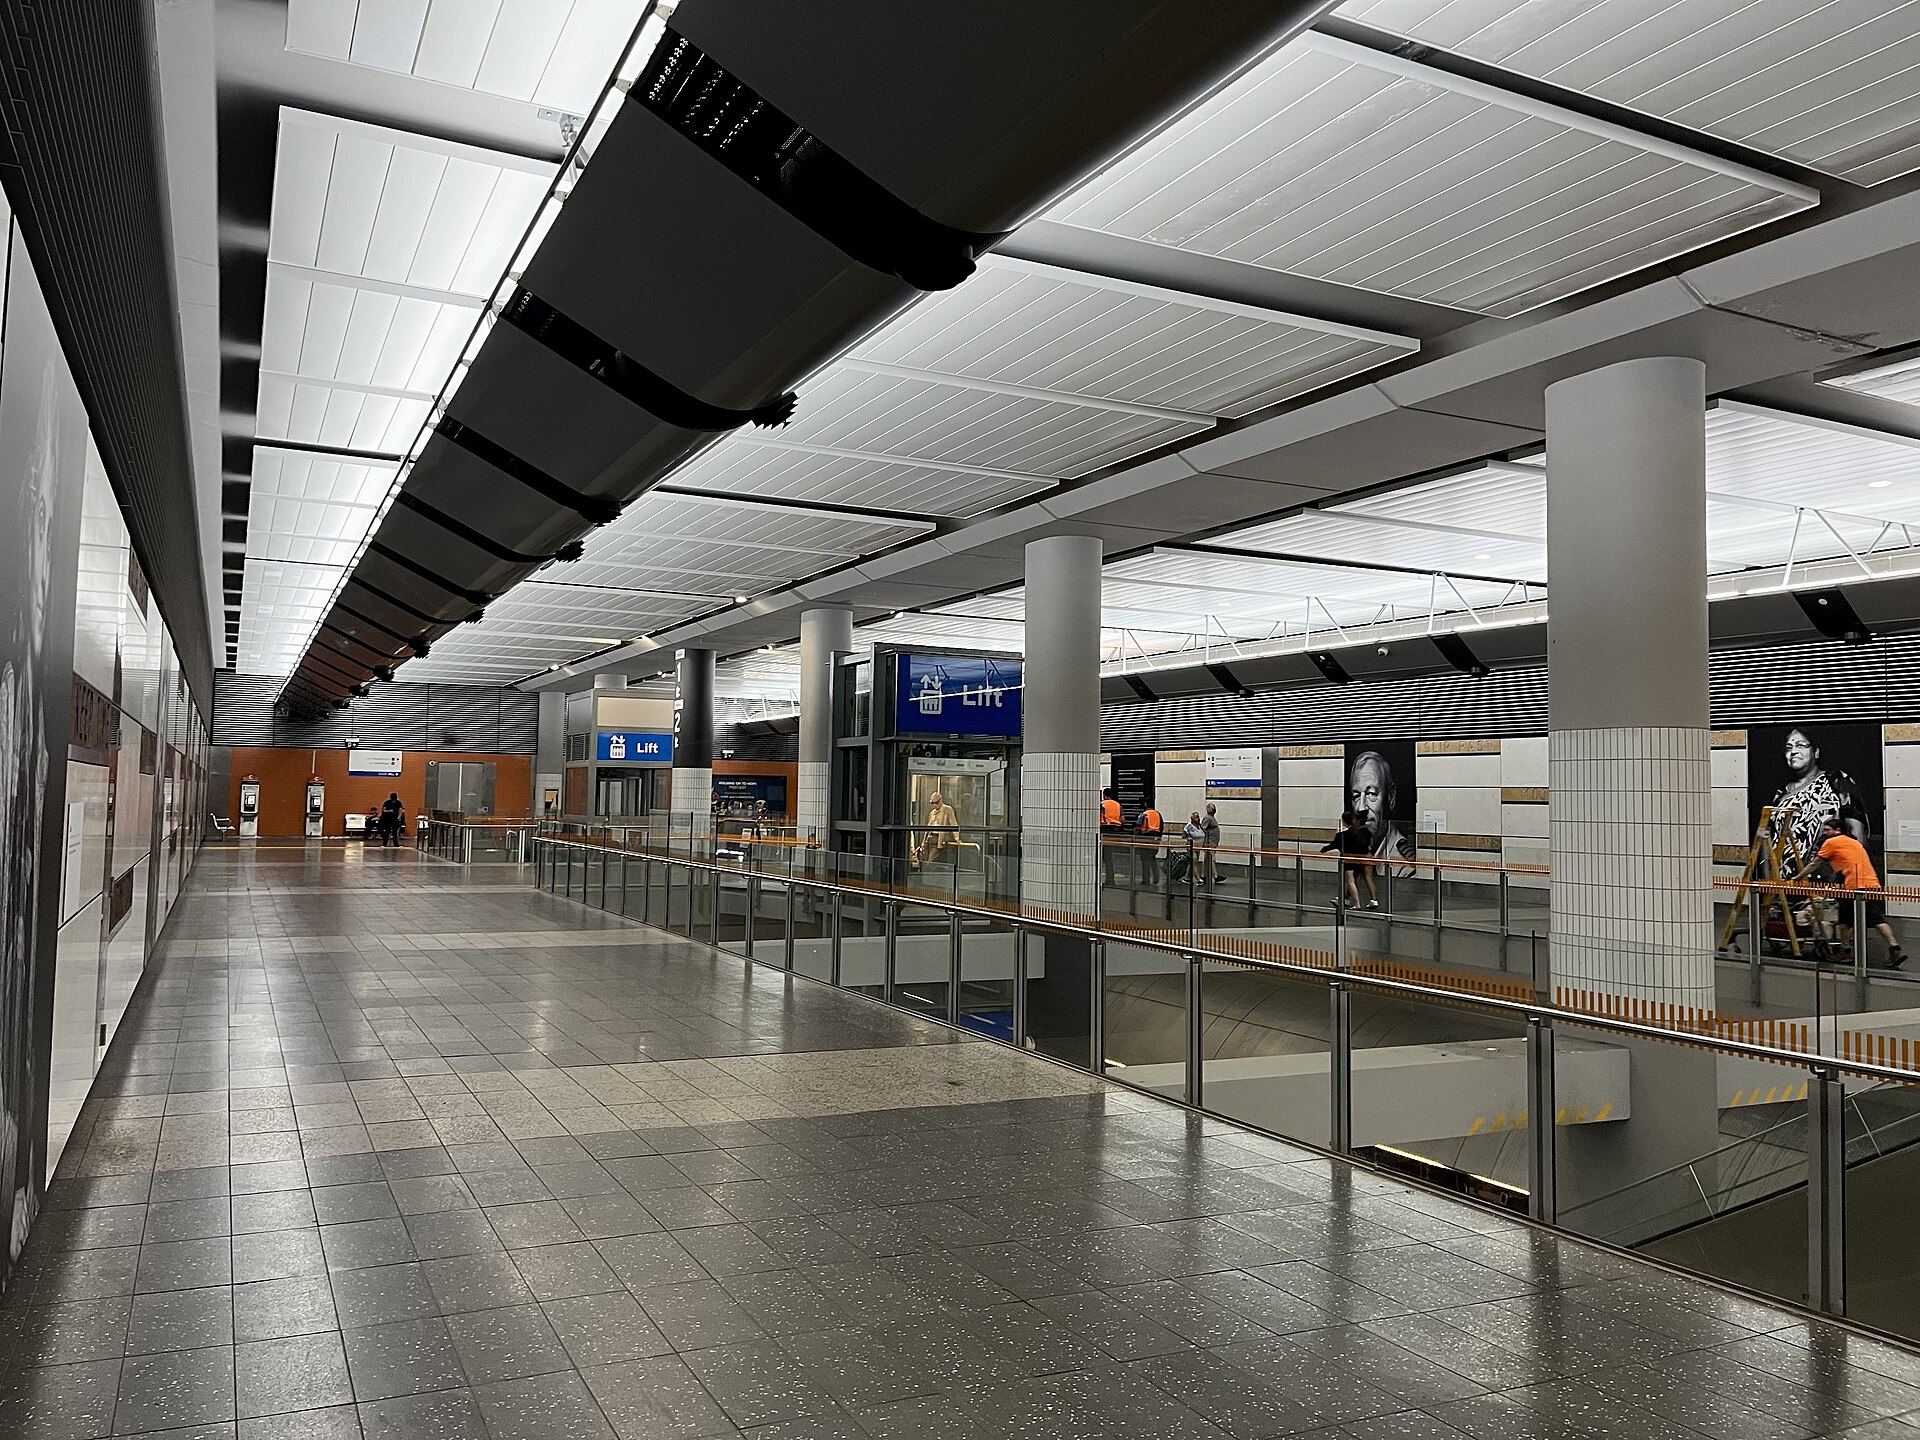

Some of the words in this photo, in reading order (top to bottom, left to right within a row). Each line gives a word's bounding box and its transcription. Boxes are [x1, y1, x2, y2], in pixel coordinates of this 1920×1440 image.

[677, 662, 682, 682] 1
[962, 684, 1003, 708] Lift
[674, 711, 682, 734] 2
[636, 742, 659, 754] Lift
